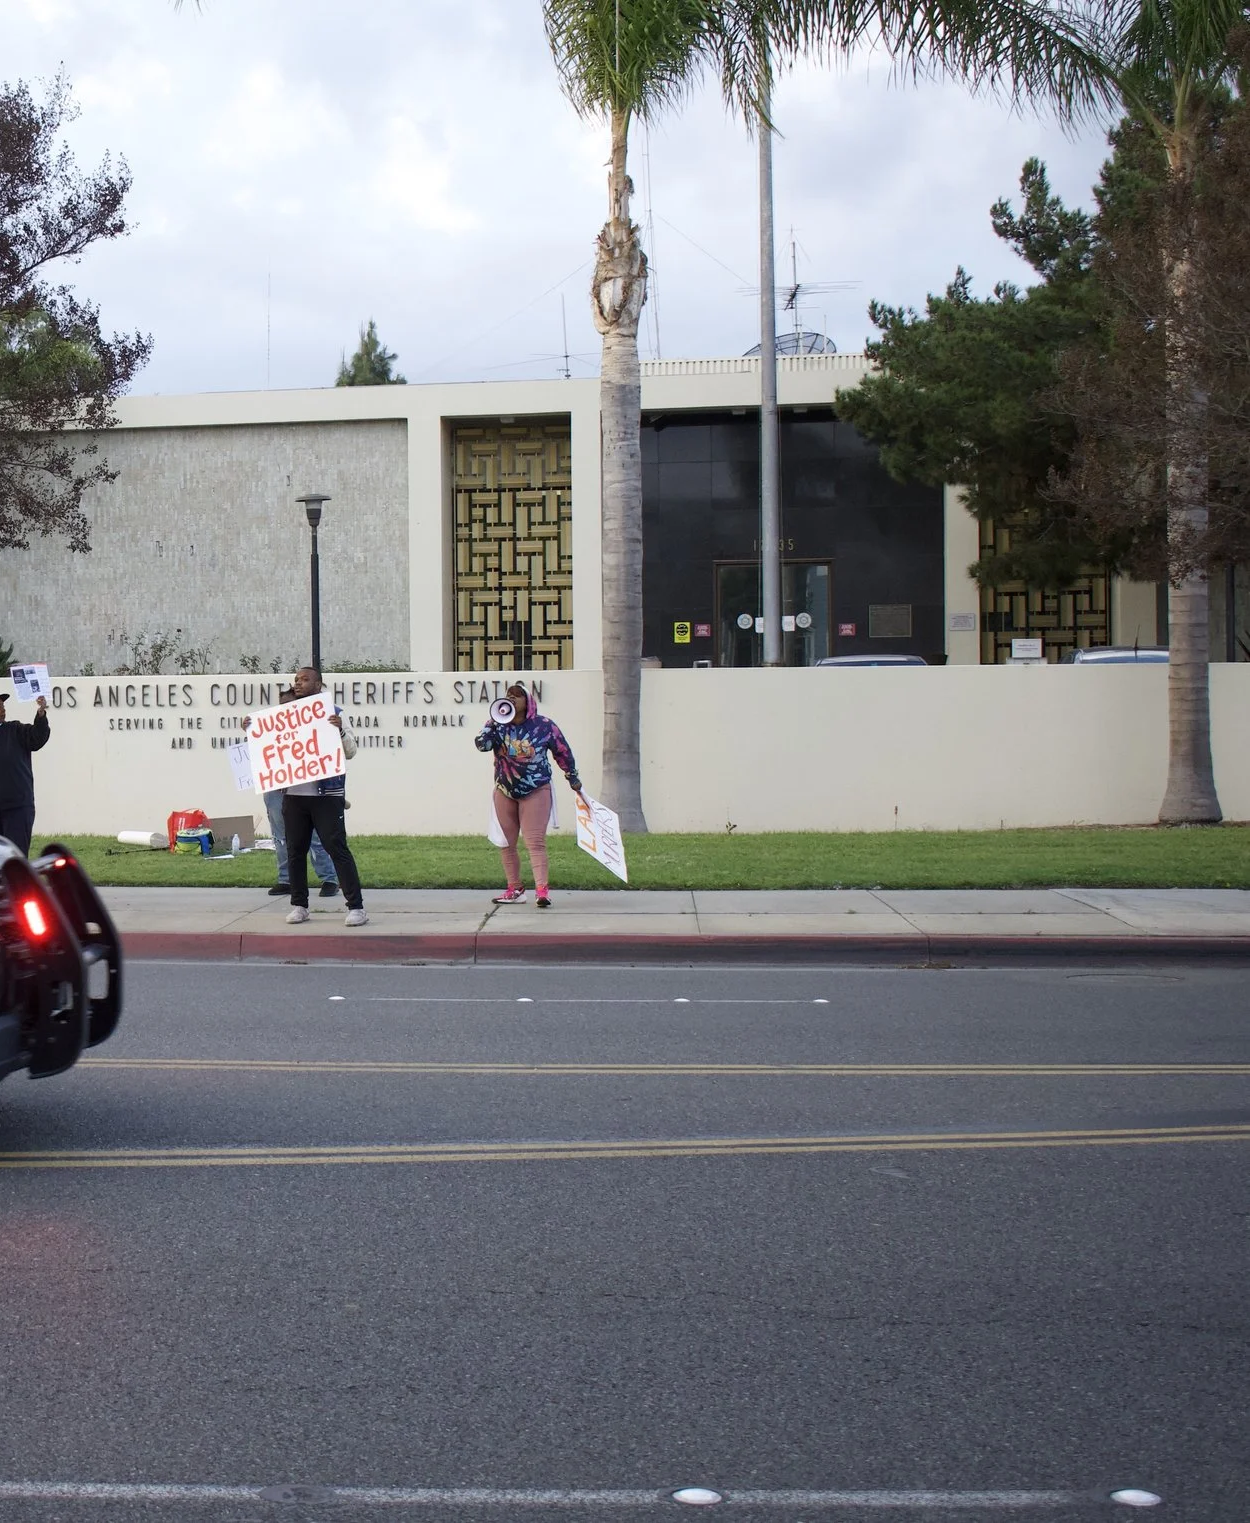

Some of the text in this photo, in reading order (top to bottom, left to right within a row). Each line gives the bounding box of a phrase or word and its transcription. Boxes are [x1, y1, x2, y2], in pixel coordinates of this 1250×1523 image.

[45, 686, 77, 708] OS
[93, 684, 193, 708] ANGELES
[210, 682, 294, 706] COUNT
[321, 680, 434, 706] HERIFF'S
[109, 718, 164, 730] SERVING
[180, 717, 202, 729] THE
[403, 715, 464, 727] NORWALK
[171, 735, 403, 749] AND HITTIER
[275, 731, 299, 744] for
[262, 729, 320, 770] Fred
[259, 747, 341, 790] Holder!
